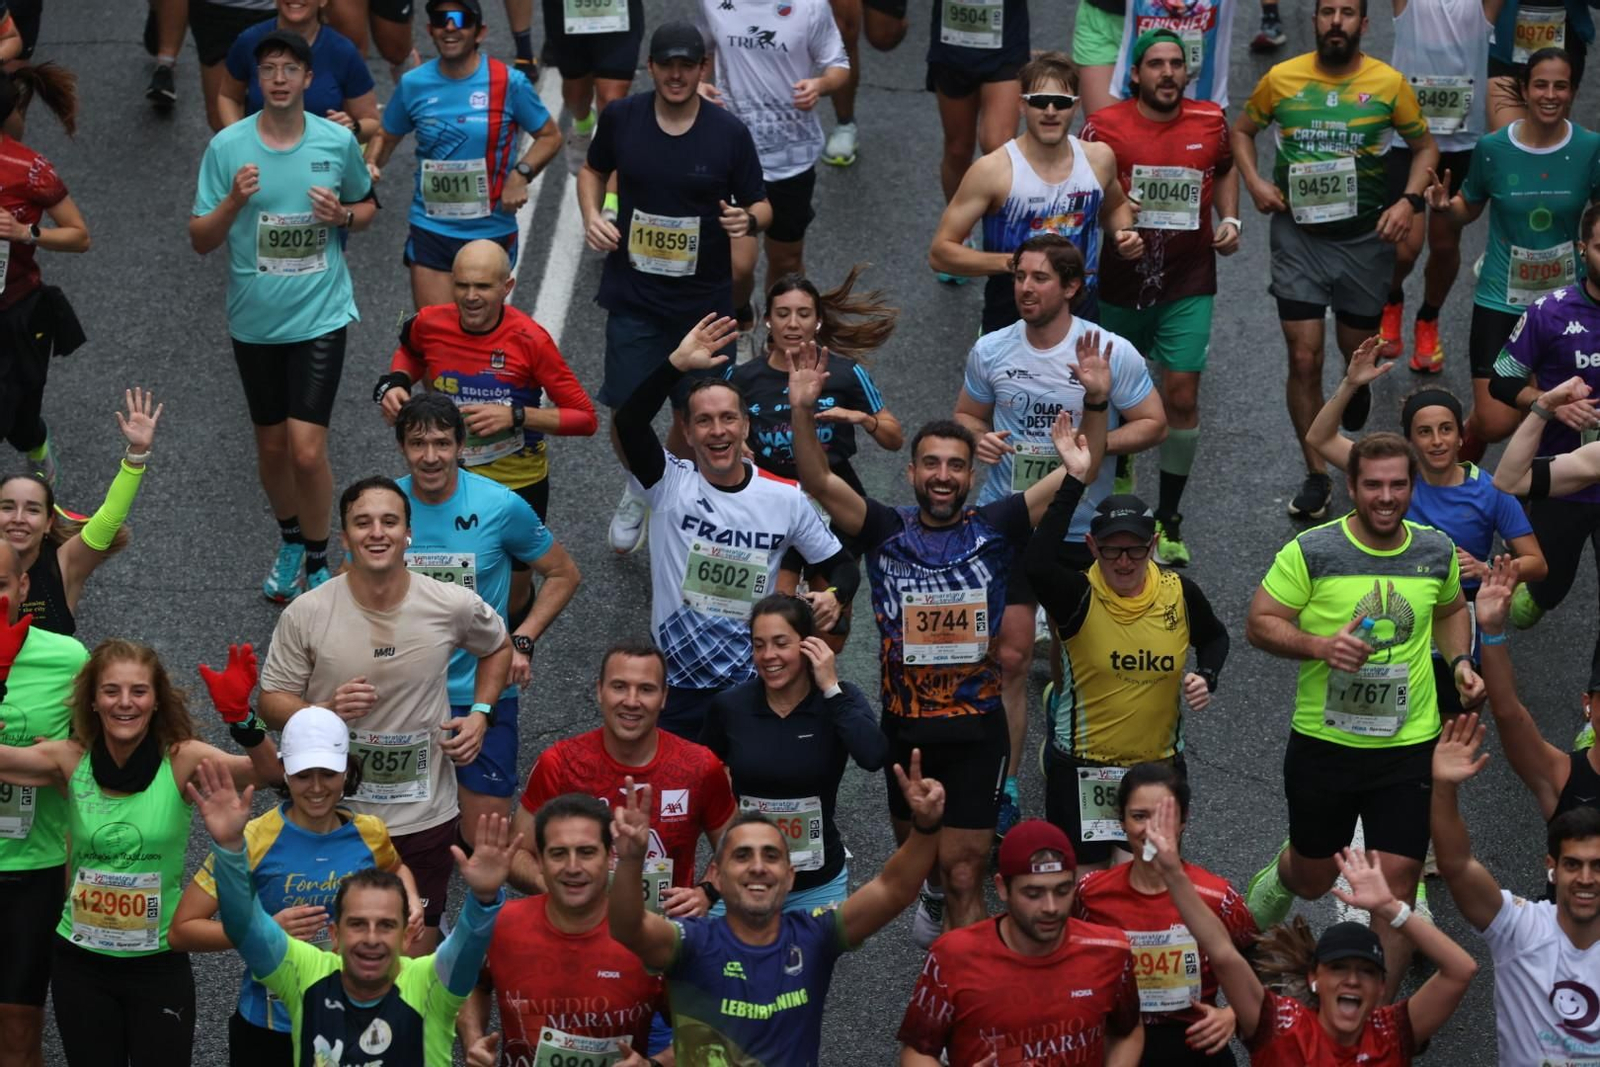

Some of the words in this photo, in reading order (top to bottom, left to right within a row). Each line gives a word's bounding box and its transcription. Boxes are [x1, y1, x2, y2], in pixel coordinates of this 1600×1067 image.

[727, 34, 789, 53] TRIANA
[1417, 90, 1459, 109] 8492
[431, 175, 470, 194] 9011
[1138, 182, 1191, 202] 10040
[1298, 175, 1342, 197] 9452
[268, 228, 315, 249] 9202
[636, 227, 689, 251] 11859
[758, 427, 833, 448] MAID
[698, 561, 749, 589] 6502
[916, 609, 969, 632] 3744
[1110, 649, 1175, 673] teika
[358, 748, 412, 773] 7857
[660, 802, 684, 814] AXA
[284, 870, 353, 894] Fondis
[78, 889, 147, 918] 12960
[597, 970, 621, 979] HOKA
[1071, 988, 1093, 998] HOKA
[1024, 1025, 1101, 1060] MARAT
